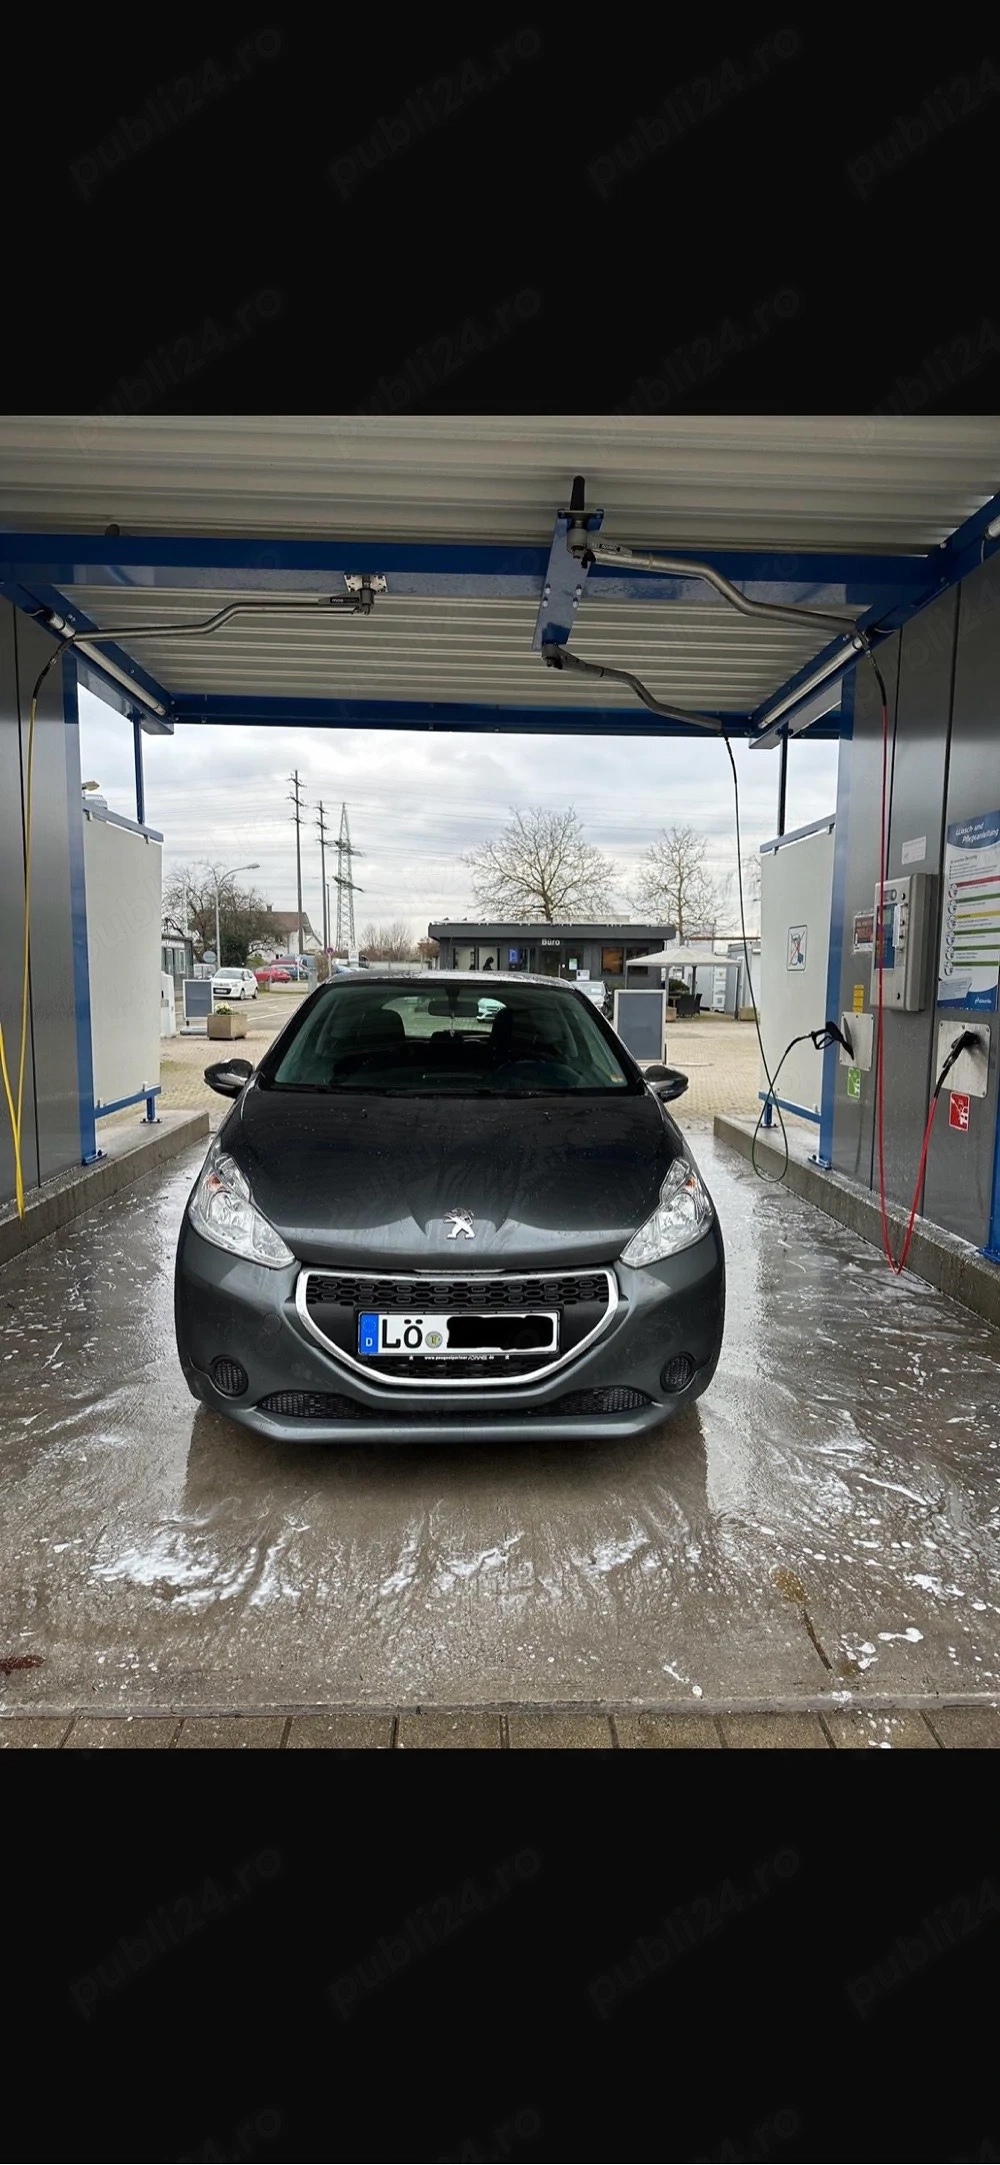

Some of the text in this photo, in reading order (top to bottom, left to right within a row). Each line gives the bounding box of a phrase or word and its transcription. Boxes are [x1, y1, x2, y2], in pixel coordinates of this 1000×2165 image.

[541, 938, 561, 946] Büro
[382, 1319, 424, 1349] LÖ
[365, 1337, 374, 1347] D
